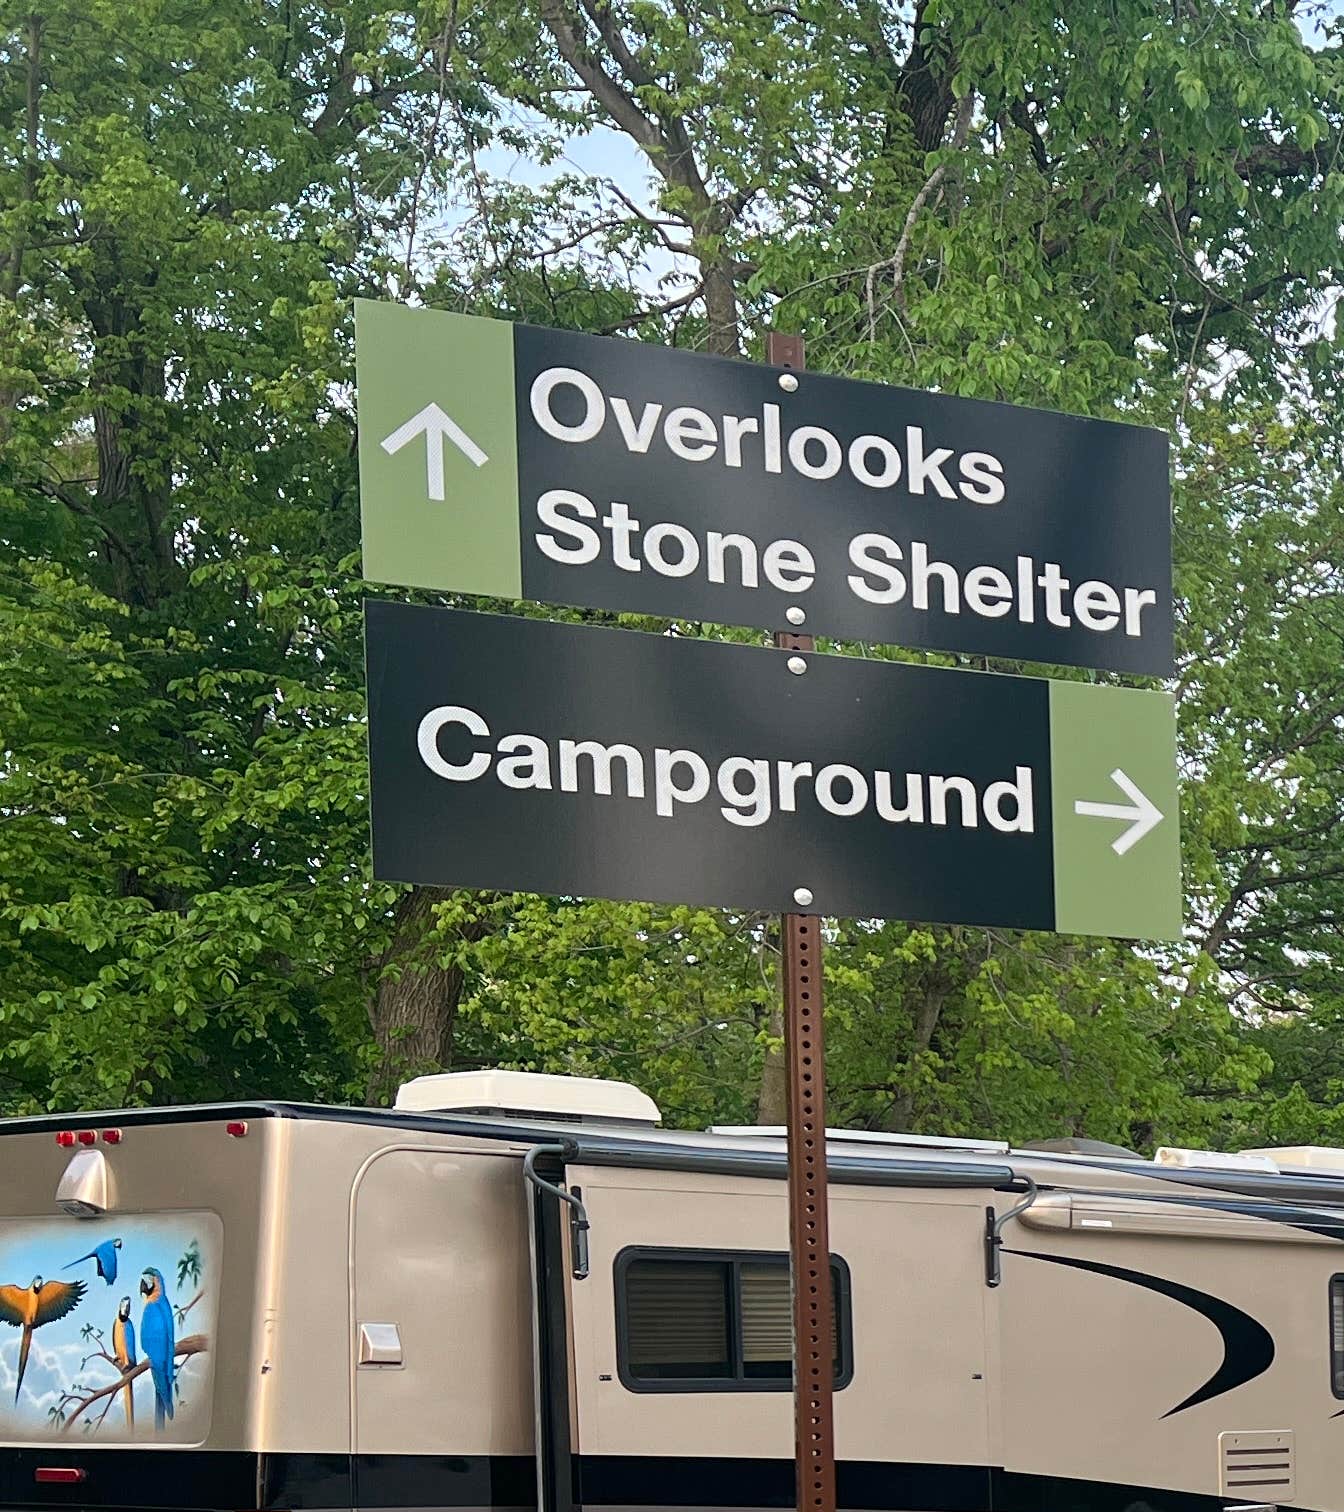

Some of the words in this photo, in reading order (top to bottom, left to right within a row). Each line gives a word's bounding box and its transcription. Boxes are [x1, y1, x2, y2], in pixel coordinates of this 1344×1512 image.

[529, 367, 1006, 505] Overlooks
[534, 489, 817, 594] Stone
[847, 533, 1158, 638] Shelter
[416, 705, 1035, 834] Campground
